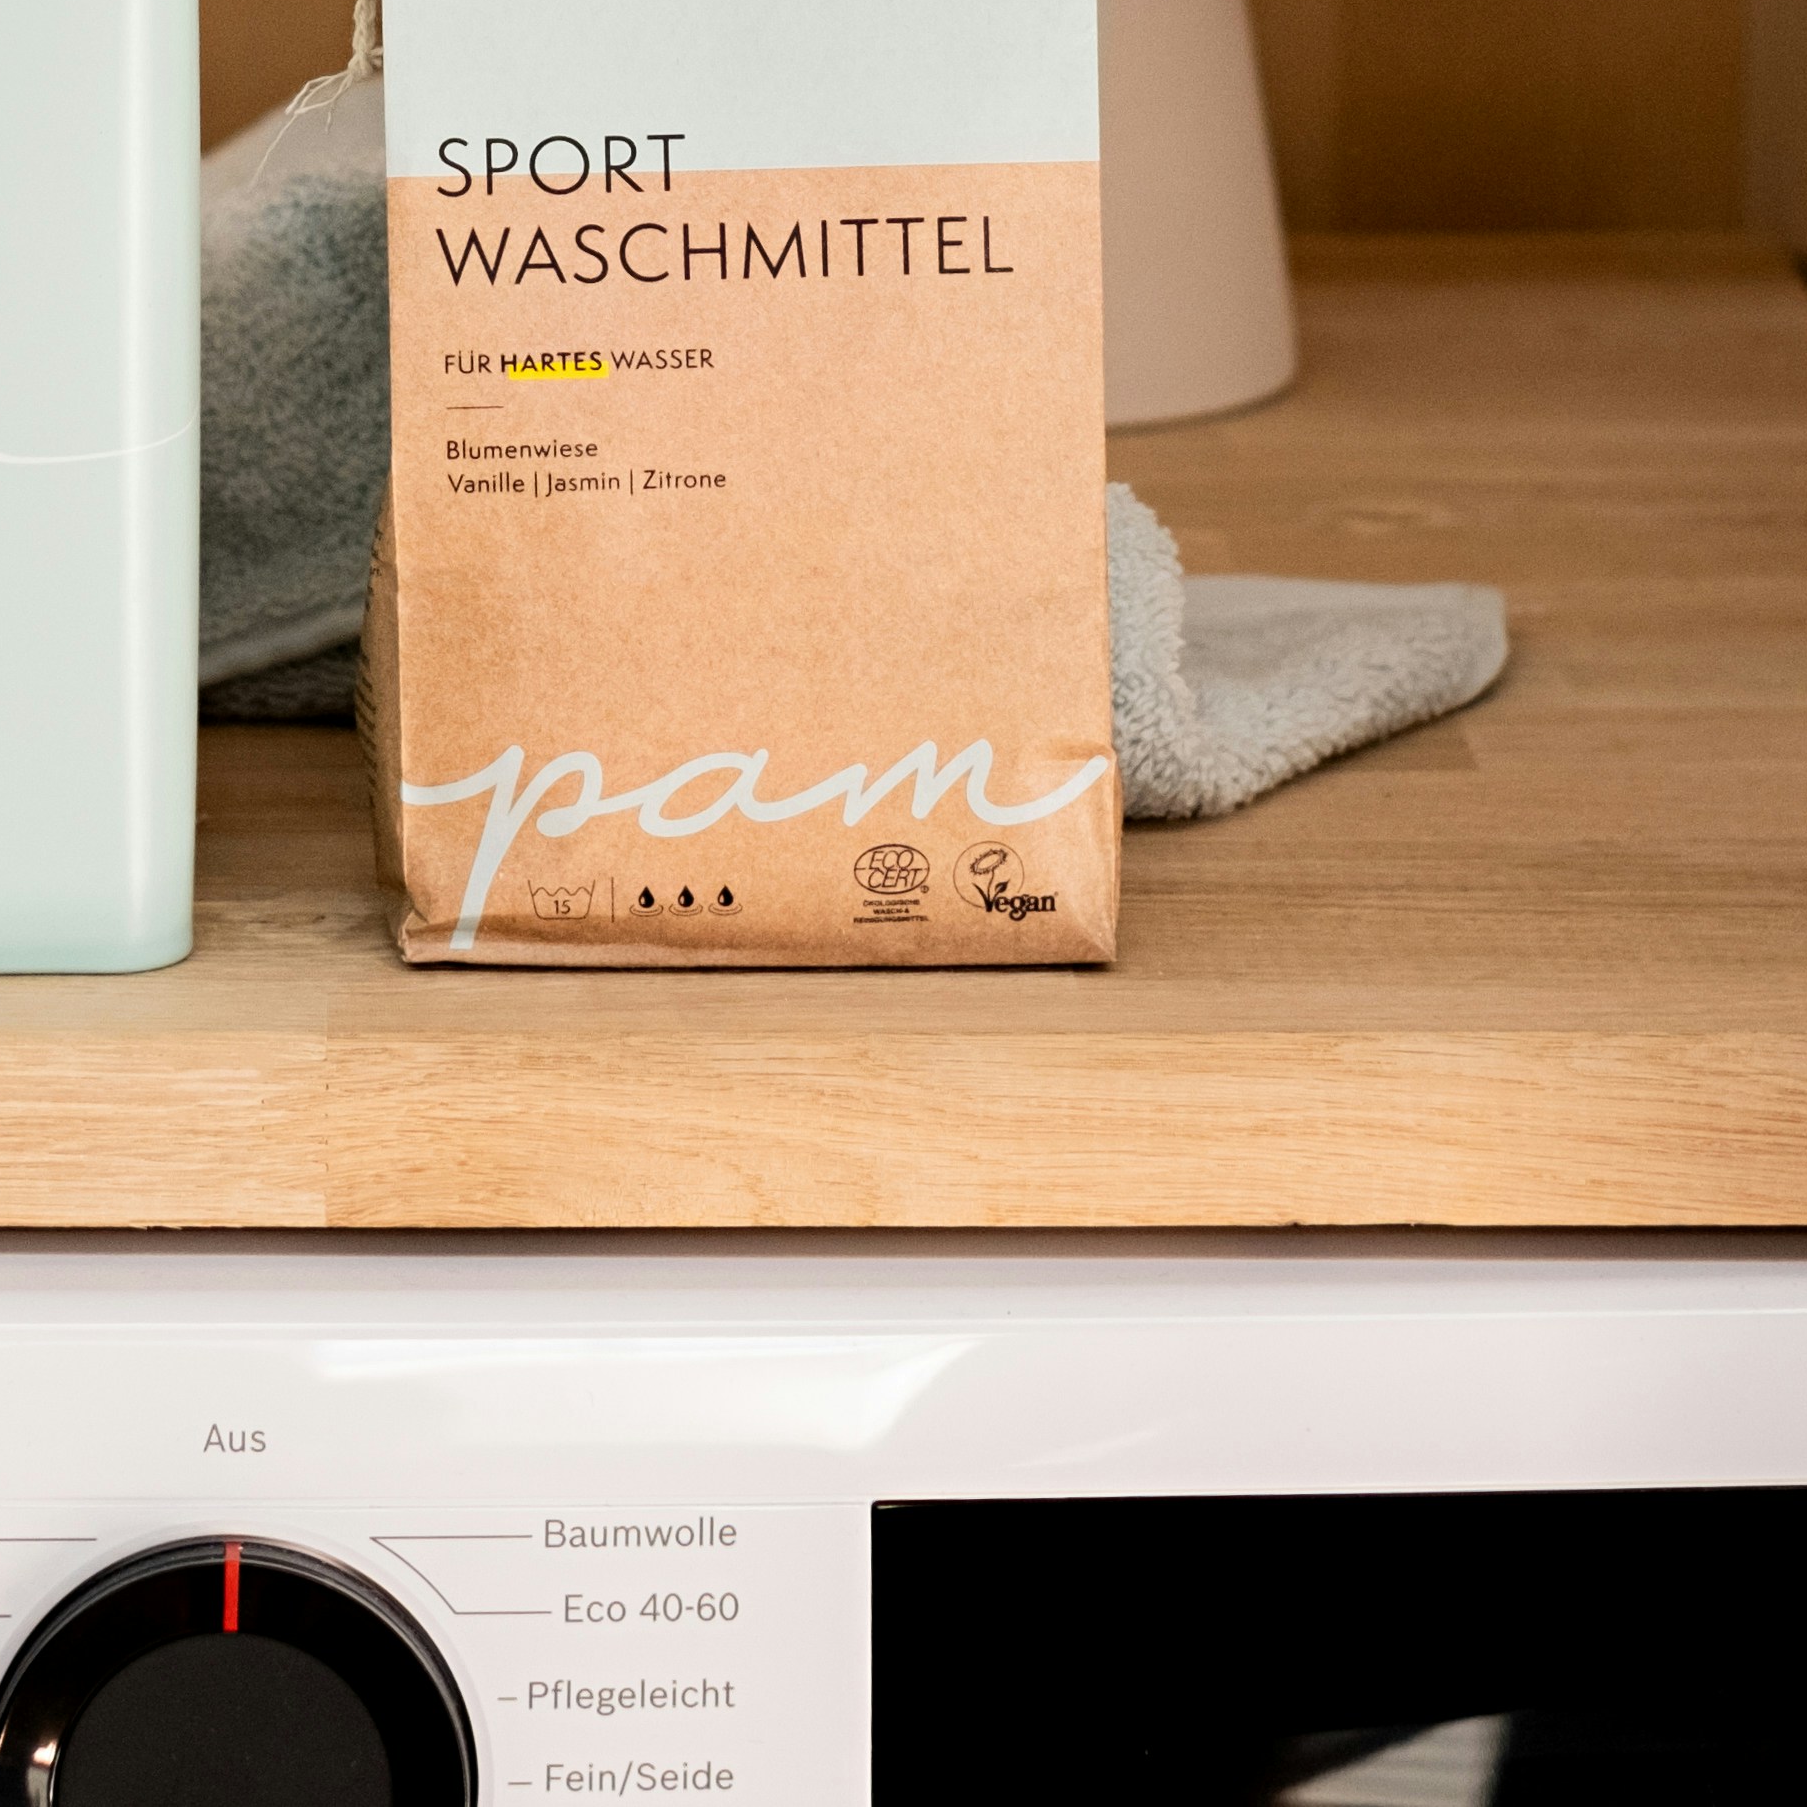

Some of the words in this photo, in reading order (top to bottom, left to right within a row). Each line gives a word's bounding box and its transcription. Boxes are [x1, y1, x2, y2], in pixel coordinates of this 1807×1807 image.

[436, 134, 686, 197] SPORT
[436, 215, 1015, 286] WASCHMITTEL
[444, 350, 492, 374] FÜR
[500, 351, 603, 373] HARTES
[611, 348, 715, 370] WASSER
[446, 439, 599, 461] Blumenwiese
[448, 471, 525, 494] Vanille
[545, 471, 621, 497] Jasmin
[643, 468, 727, 490] Zitrone
[400, 738, 1108, 950] pam
[867, 849, 915, 870] ECO
[867, 867, 923, 889] CERT
[552, 897, 572, 917] 15
[972, 882, 1057, 922] Vegan
[202, 1422, 268, 1455] Aus
[544, 1516, 738, 1549] Baumwolle
[564, 1594, 627, 1623] Eco
[639, 1592, 740, 1623] 40-60
[528, 1678, 737, 1717] Pflegeleicht
[545, 1761, 735, 1798] Fein/Seide
